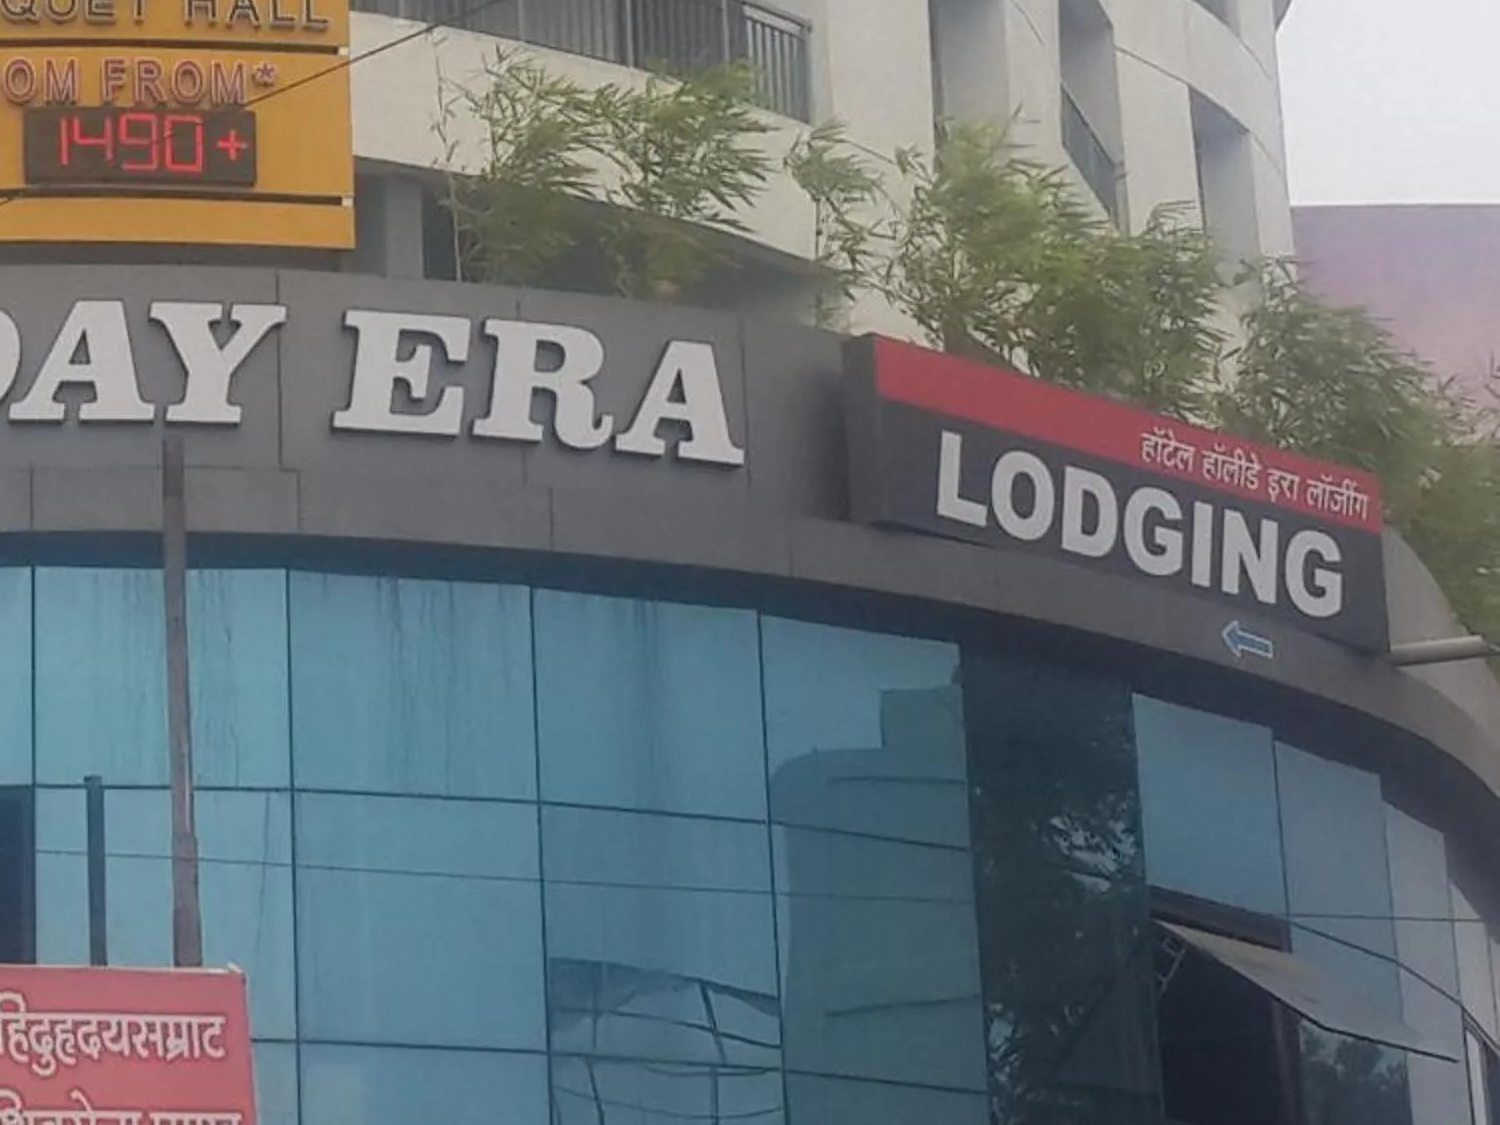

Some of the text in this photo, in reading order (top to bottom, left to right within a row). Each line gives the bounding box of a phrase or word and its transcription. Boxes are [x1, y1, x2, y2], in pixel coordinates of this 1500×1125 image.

[331, 310, 744, 465] ERA
[1140, 426, 1197, 472] हॉटेल
[1267, 467, 1301, 503] इरा
[937, 430, 1344, 618] LODGING
